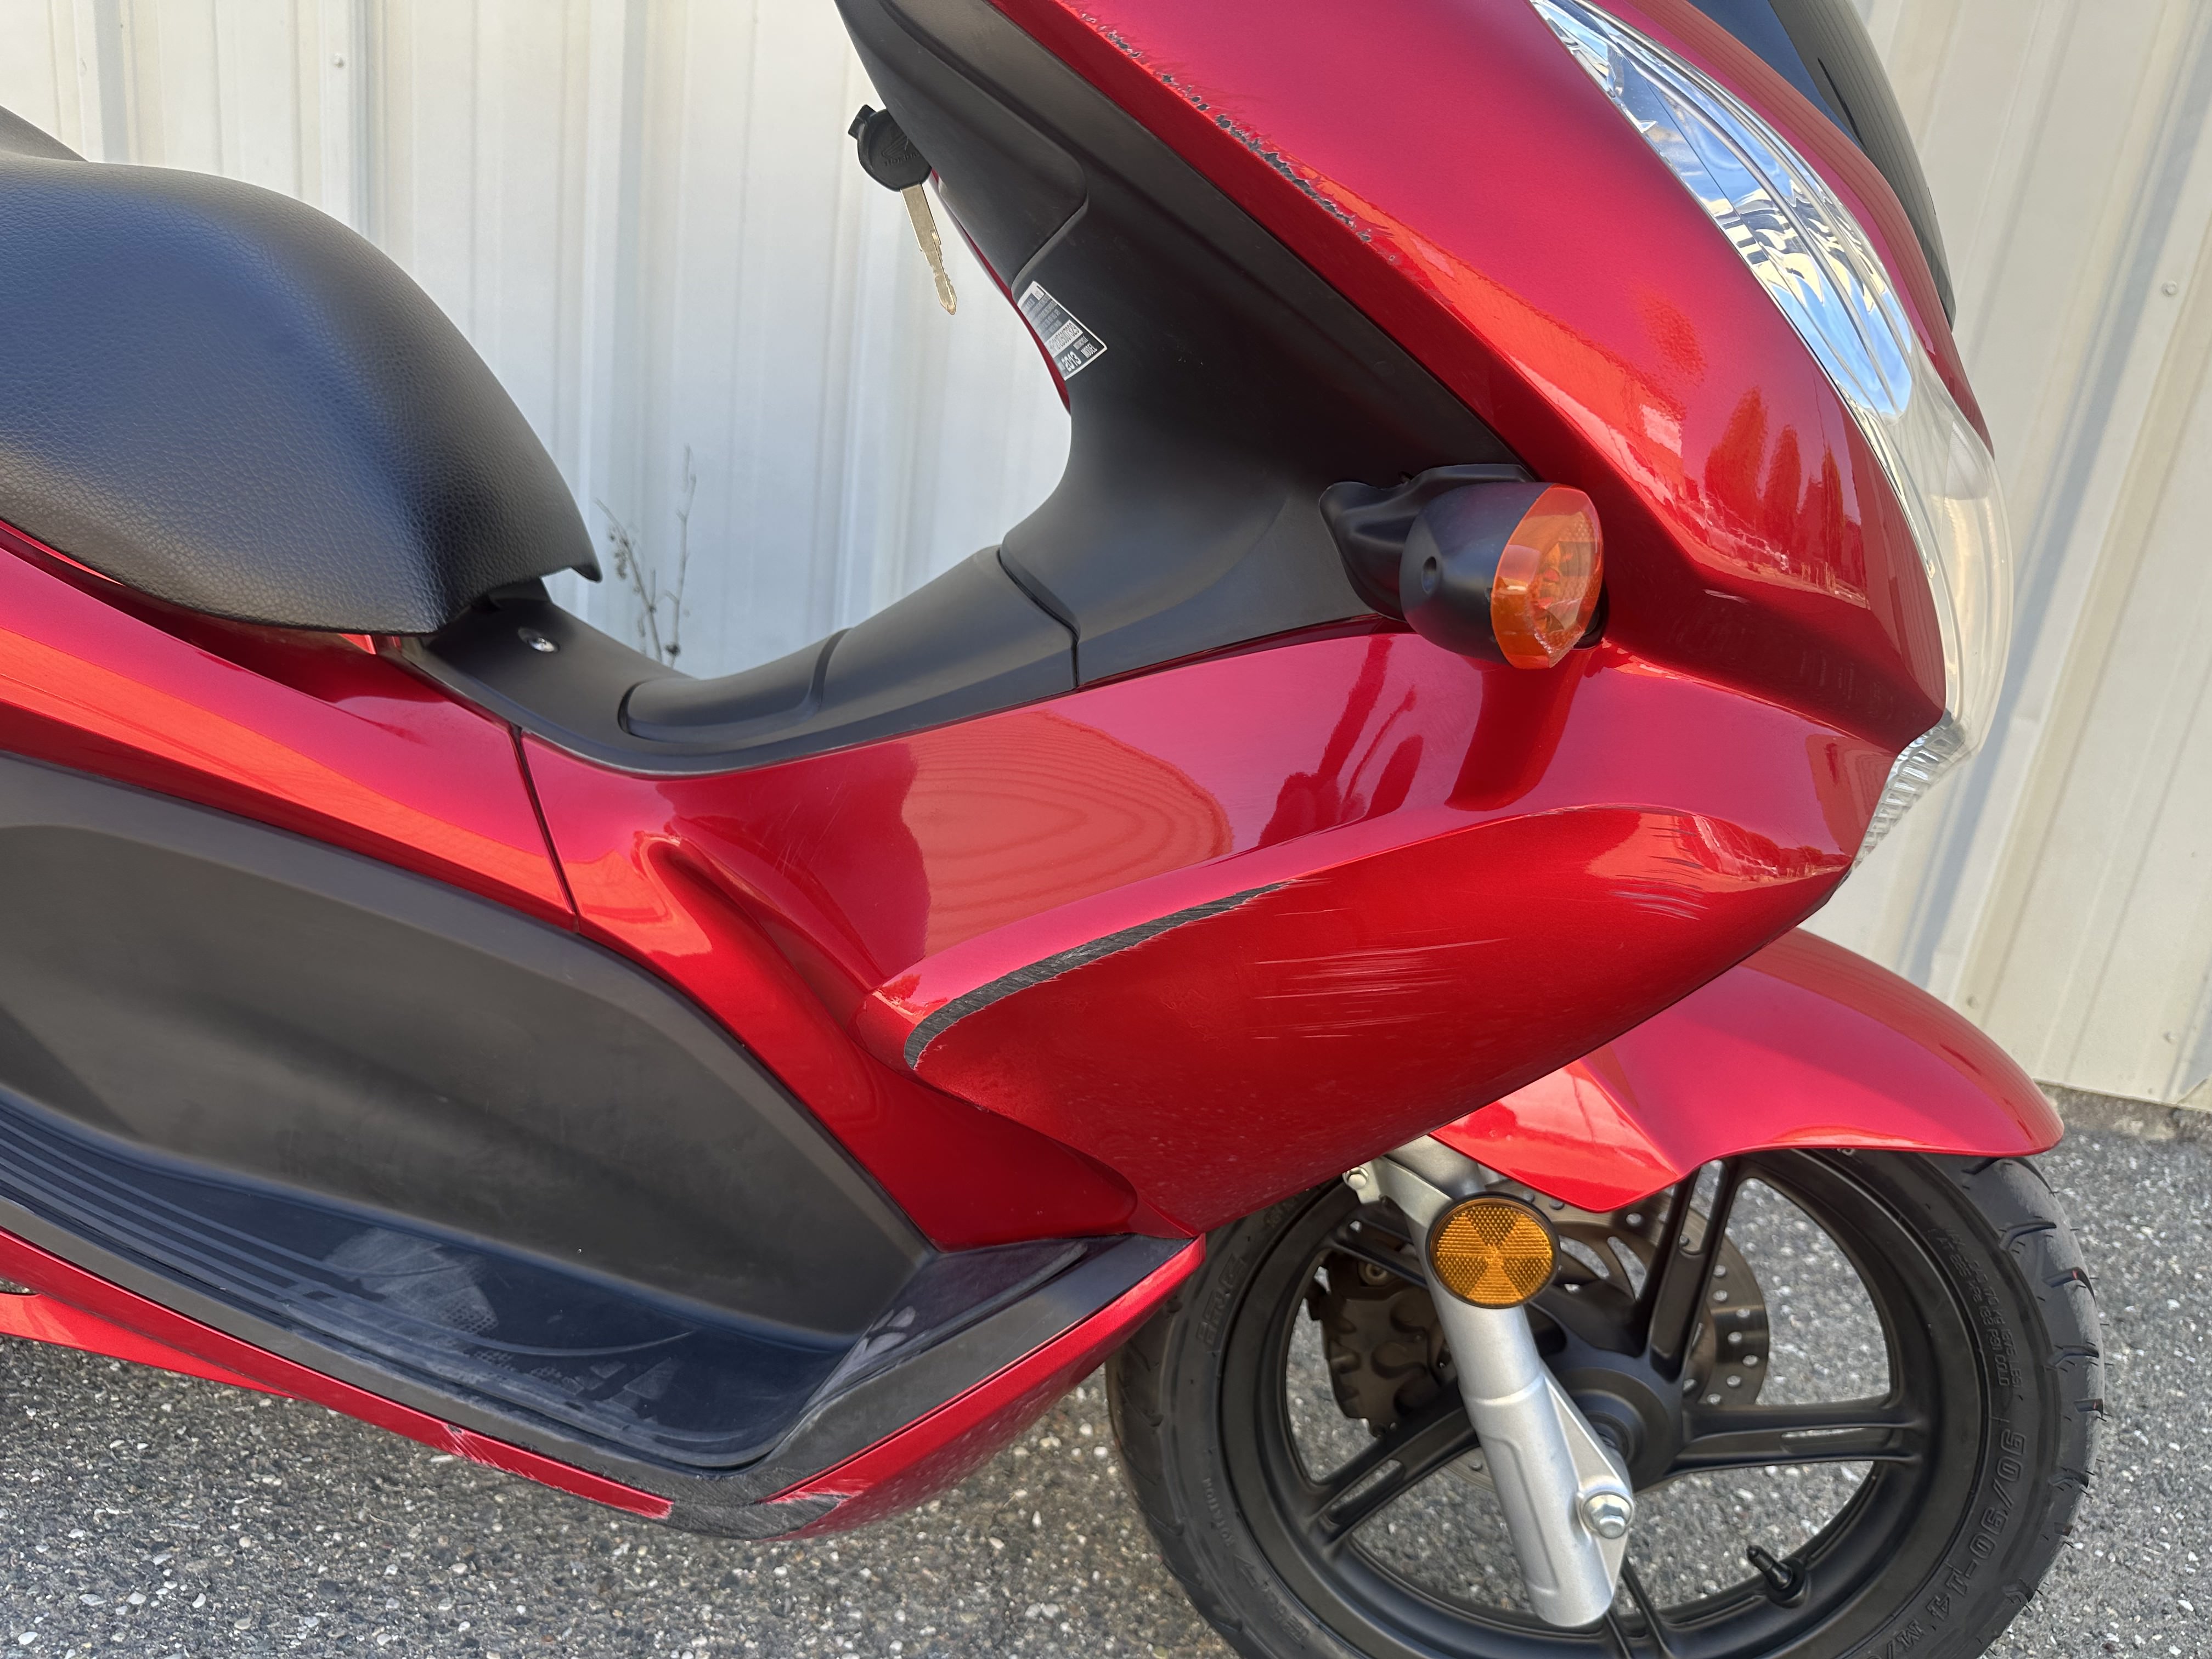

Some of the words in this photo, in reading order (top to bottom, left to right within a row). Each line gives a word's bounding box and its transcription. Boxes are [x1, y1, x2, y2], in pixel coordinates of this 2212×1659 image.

[1061, 351, 1082, 372] 2013
[1080, 343, 1098, 358] MODEL
[1994, 1354, 2009, 1386] COLD
[1203, 1477, 1235, 1547] ROTATION
